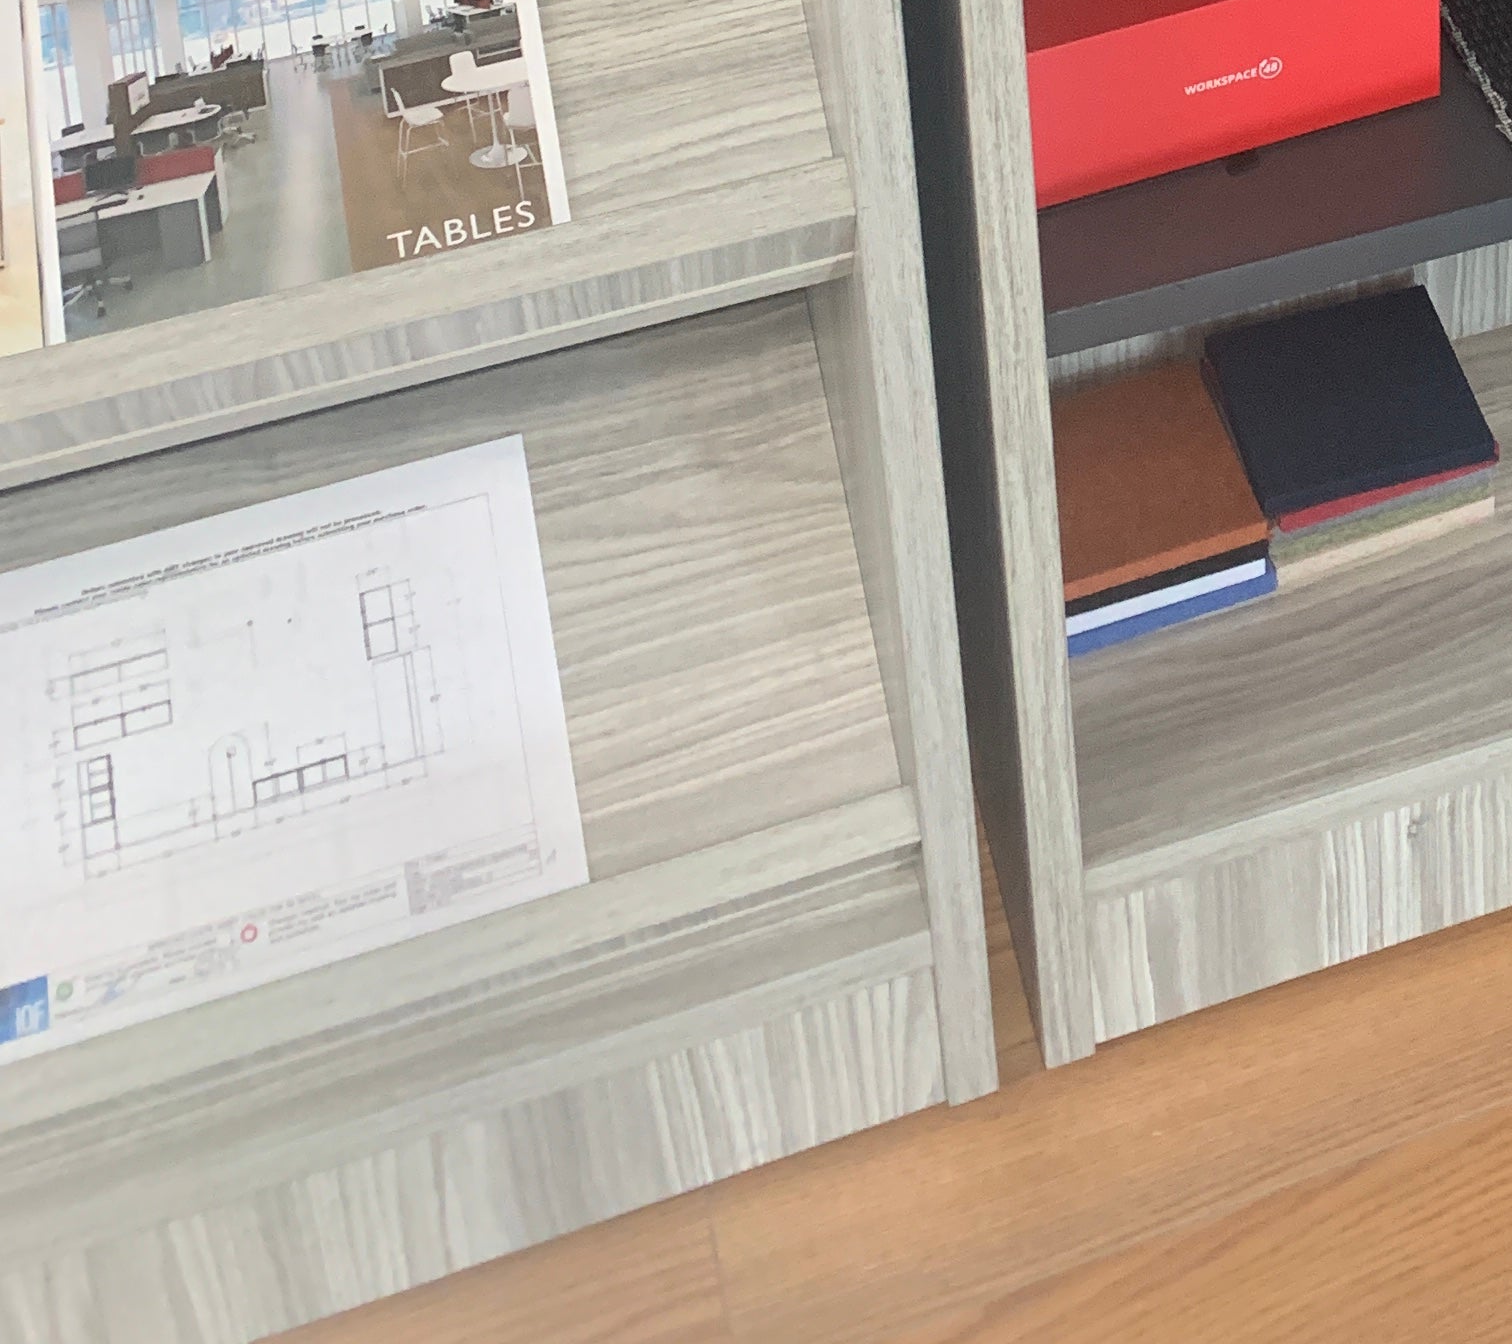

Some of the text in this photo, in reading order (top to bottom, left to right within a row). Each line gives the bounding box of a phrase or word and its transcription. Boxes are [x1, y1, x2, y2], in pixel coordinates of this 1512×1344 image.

[1184, 61, 1279, 96] WORKSPACE 48
[386, 199, 536, 259] TABLES
